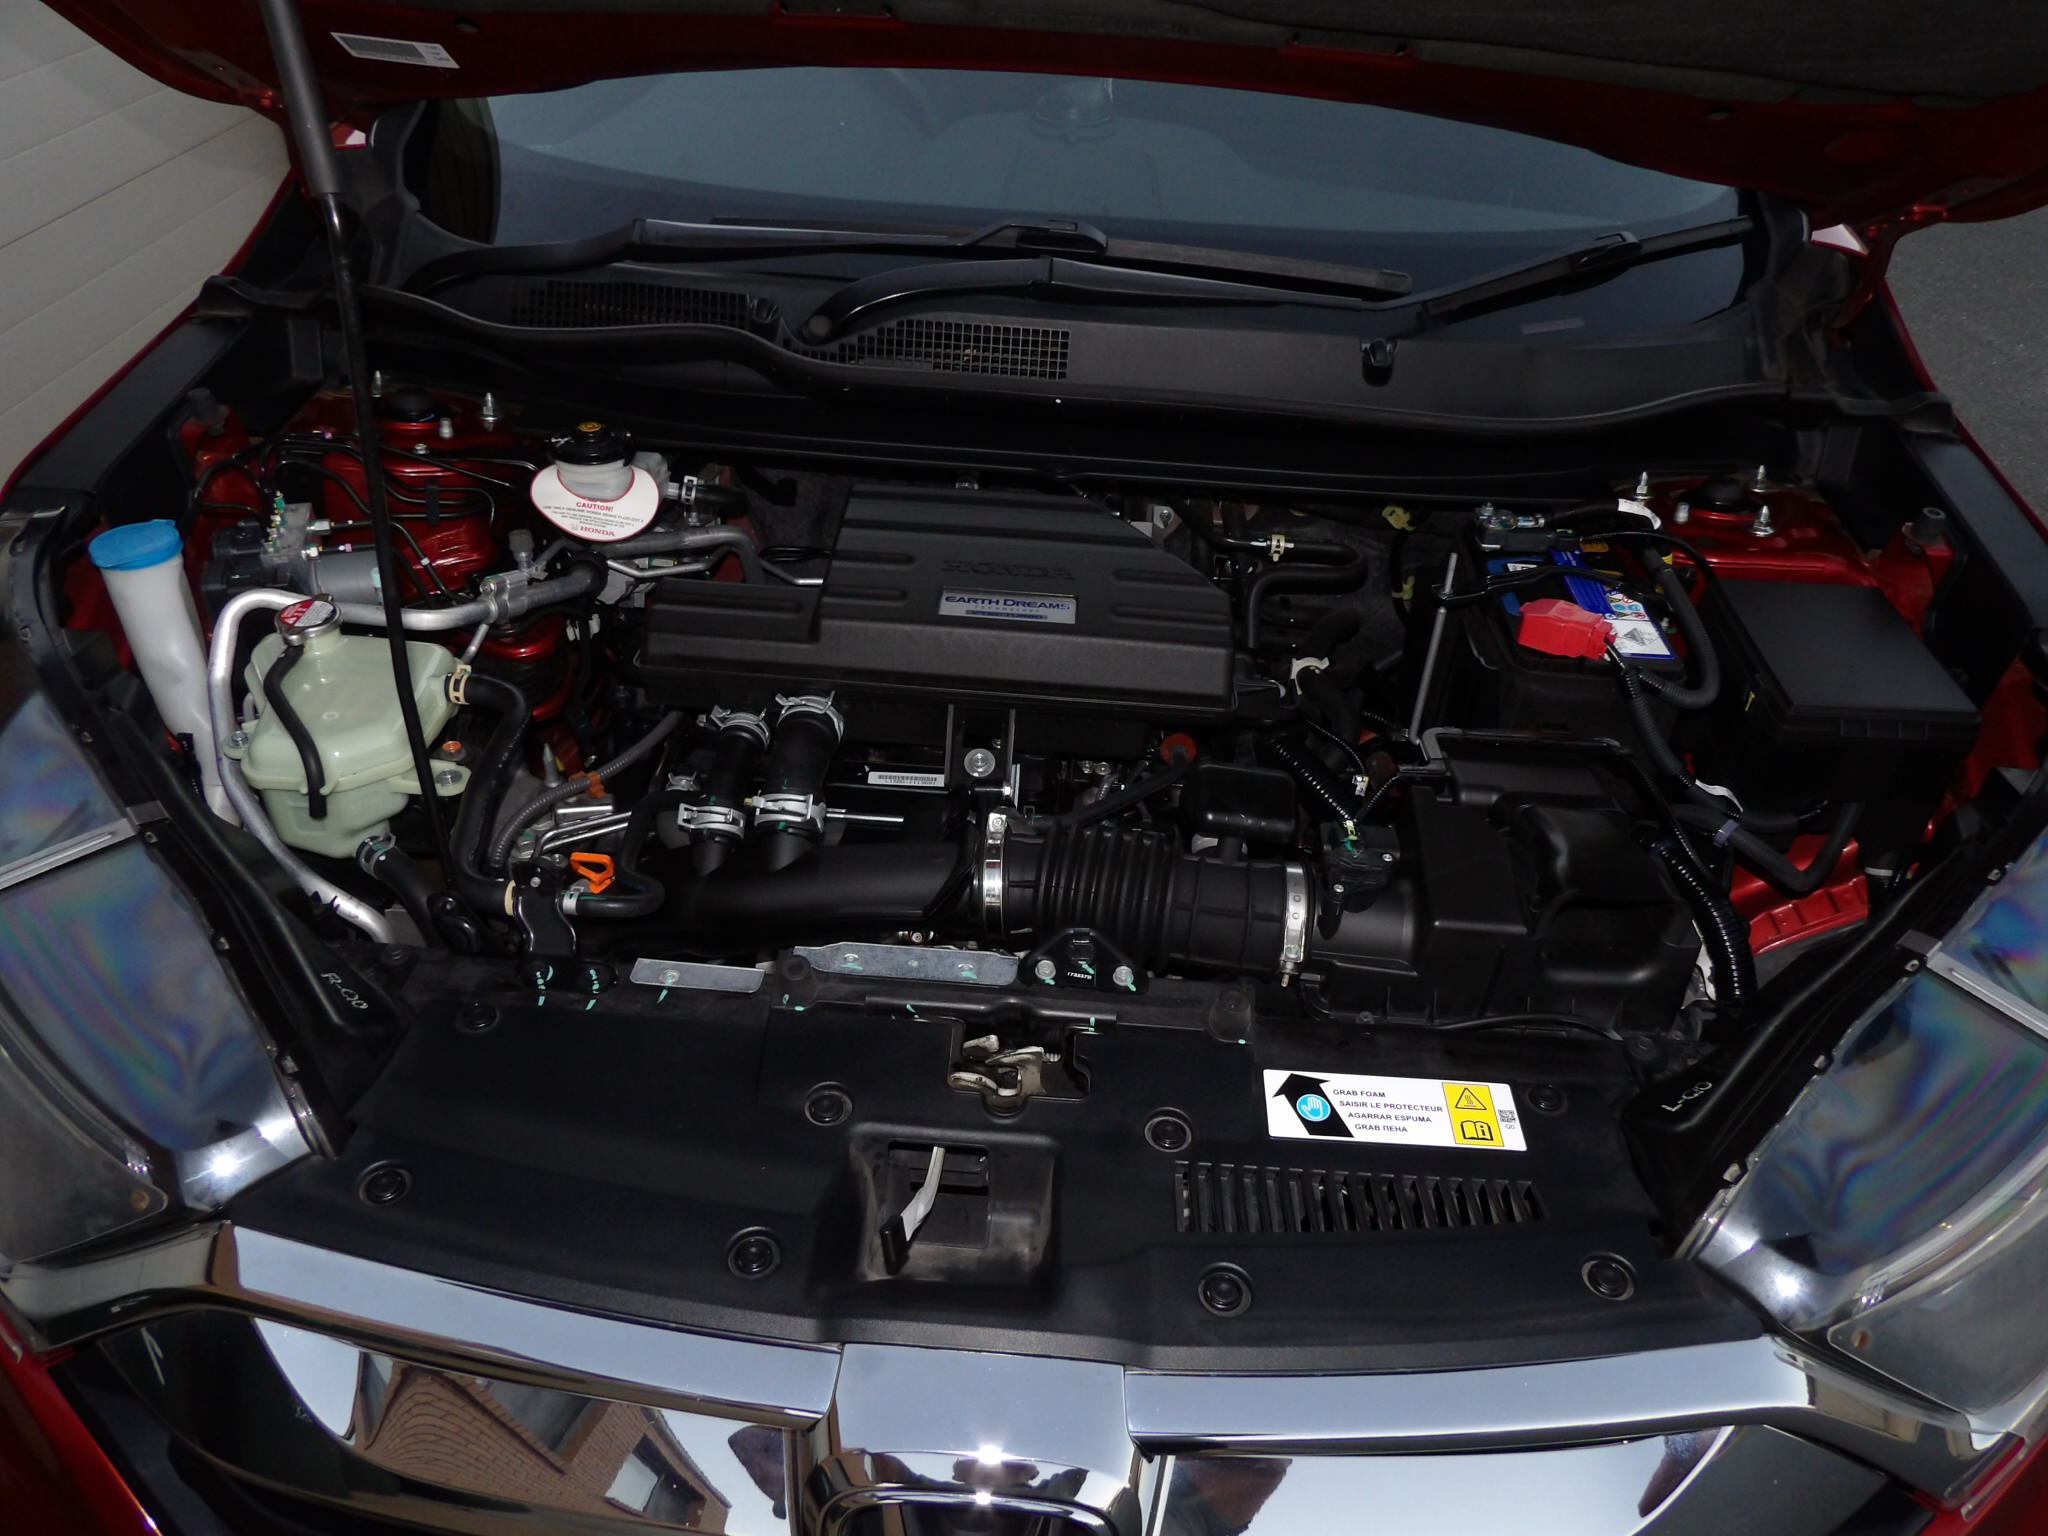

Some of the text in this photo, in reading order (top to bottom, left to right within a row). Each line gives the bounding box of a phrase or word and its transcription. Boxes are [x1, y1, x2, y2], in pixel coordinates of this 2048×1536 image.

[575, 501, 614, 512] CAUTION!
[579, 525, 616, 537] HONDA
[945, 596, 1071, 611] EARTH DREAMS
[1332, 1089, 1386, 1098] GRAB FOAM
[1339, 1100, 1368, 1108] SAISIR
[1383, 1103, 1443, 1112] PROTECTEUR
[1347, 1112, 1432, 1123] AGARRAR ESPUMA
[1354, 1123, 1381, 1131] GRAB
